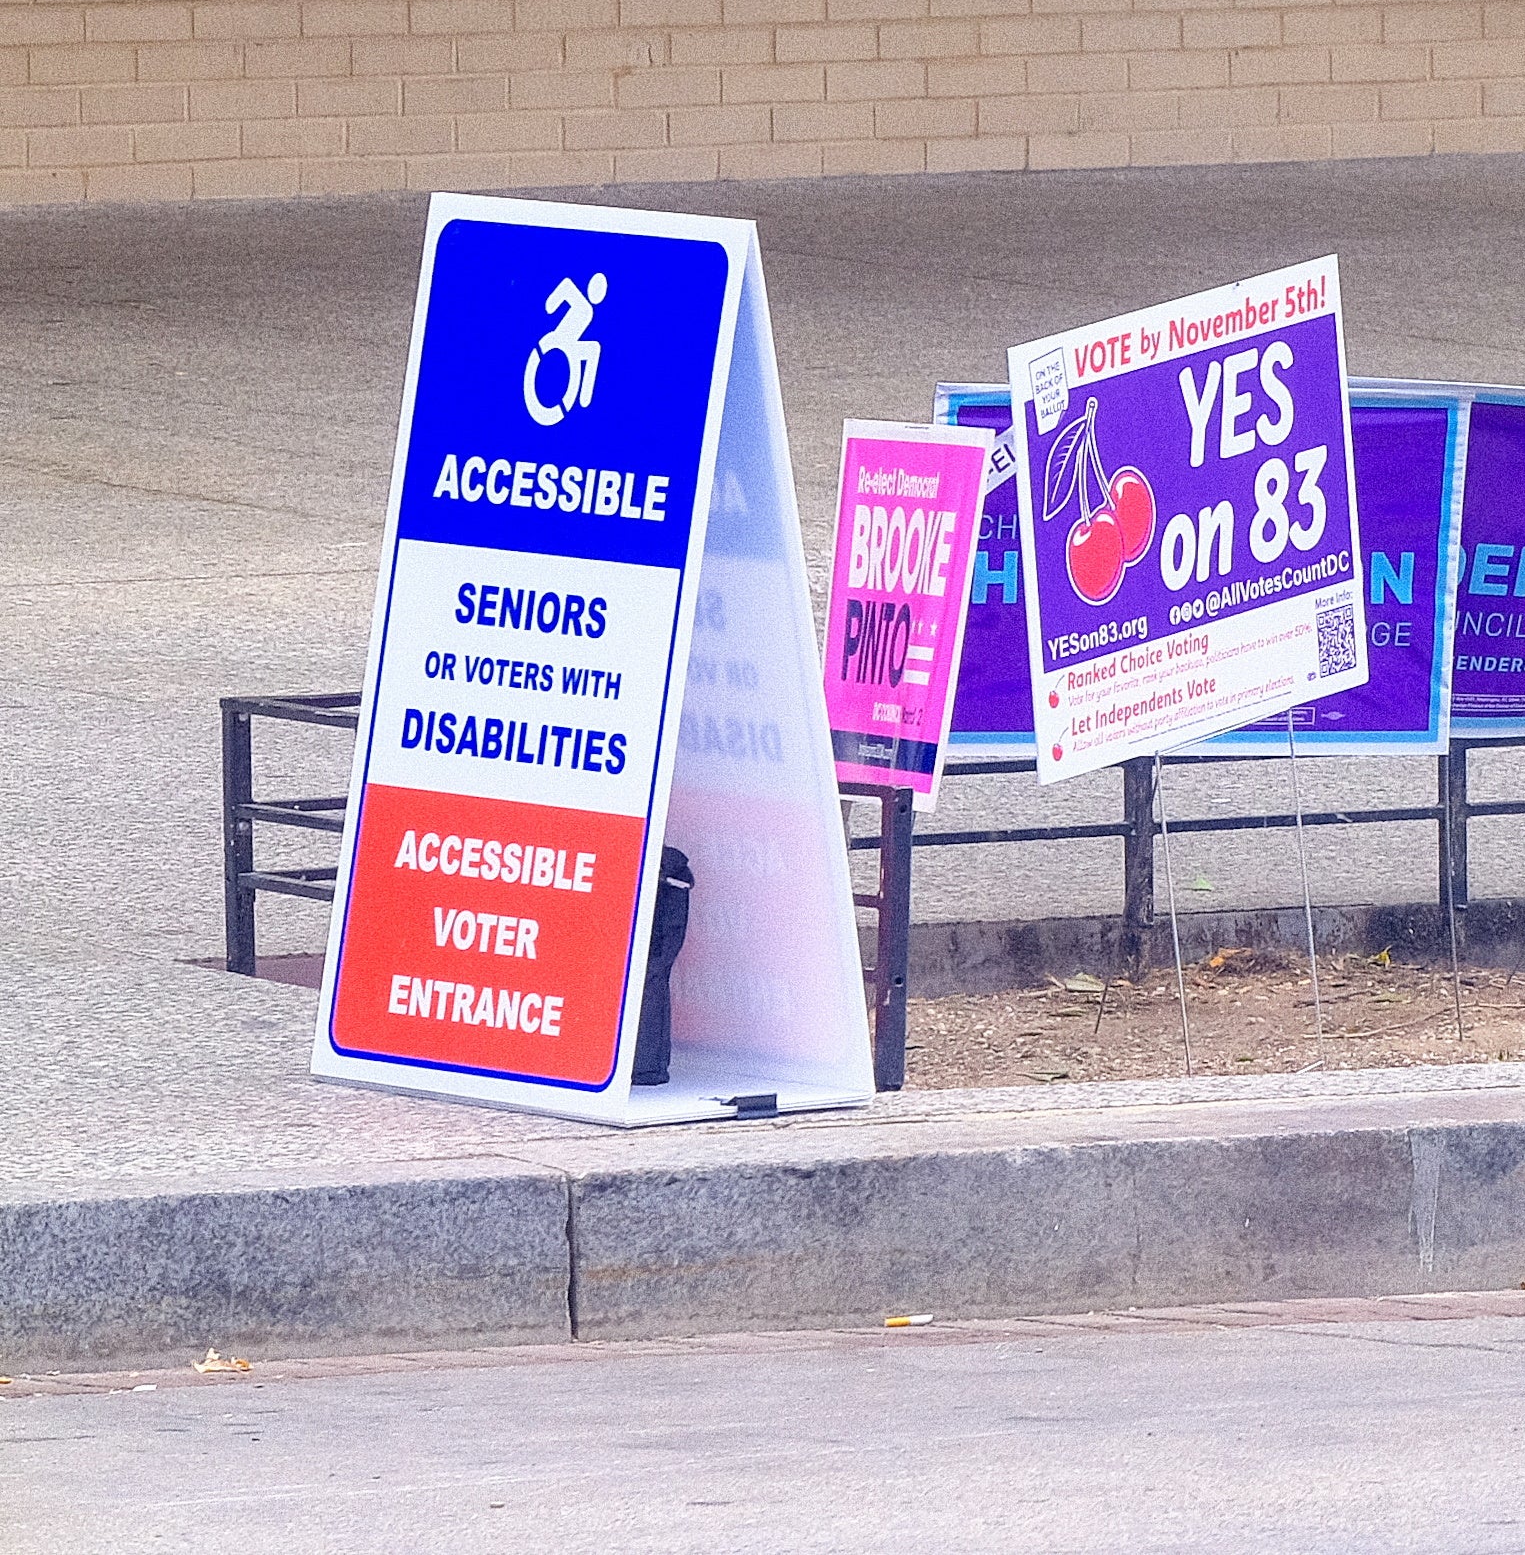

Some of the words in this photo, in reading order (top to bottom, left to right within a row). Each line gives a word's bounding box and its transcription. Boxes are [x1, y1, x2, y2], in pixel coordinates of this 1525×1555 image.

[1074, 333, 1132, 379] VOTE
[1140, 327, 1161, 360] by
[1168, 295, 1280, 349] November
[1285, 275, 1327, 319] 5th!
[1178, 341, 1294, 468] YES
[433, 454, 670, 522] ACCESSIBLE
[1160, 500, 1234, 591] on
[1249, 444, 1328, 563] 83
[848, 504, 957, 597] BROOKE
[455, 583, 608, 639] SENIORS
[1206, 550, 1349, 617] @AllVotesCountDC
[841, 599, 911, 688] PINTO
[1047, 616, 1148, 662] YESon83.org
[1068, 657, 1116, 691] Ranked
[1120, 646, 1163, 673] Choice
[1167, 633, 1209, 659] Voting
[425, 651, 457, 681] OR
[465, 656, 554, 692] VOTERS
[562, 666, 622, 700] WITH
[1072, 716, 1091, 736] Let
[1096, 688, 1183, 729] Independents
[1187, 678, 1216, 700] Vote
[401, 708, 627, 775] DISABILITIES
[394, 829, 597, 893] ACCESSIBLE
[433, 906, 540, 960] VOTER
[387, 974, 565, 1037] ENTRANCE
